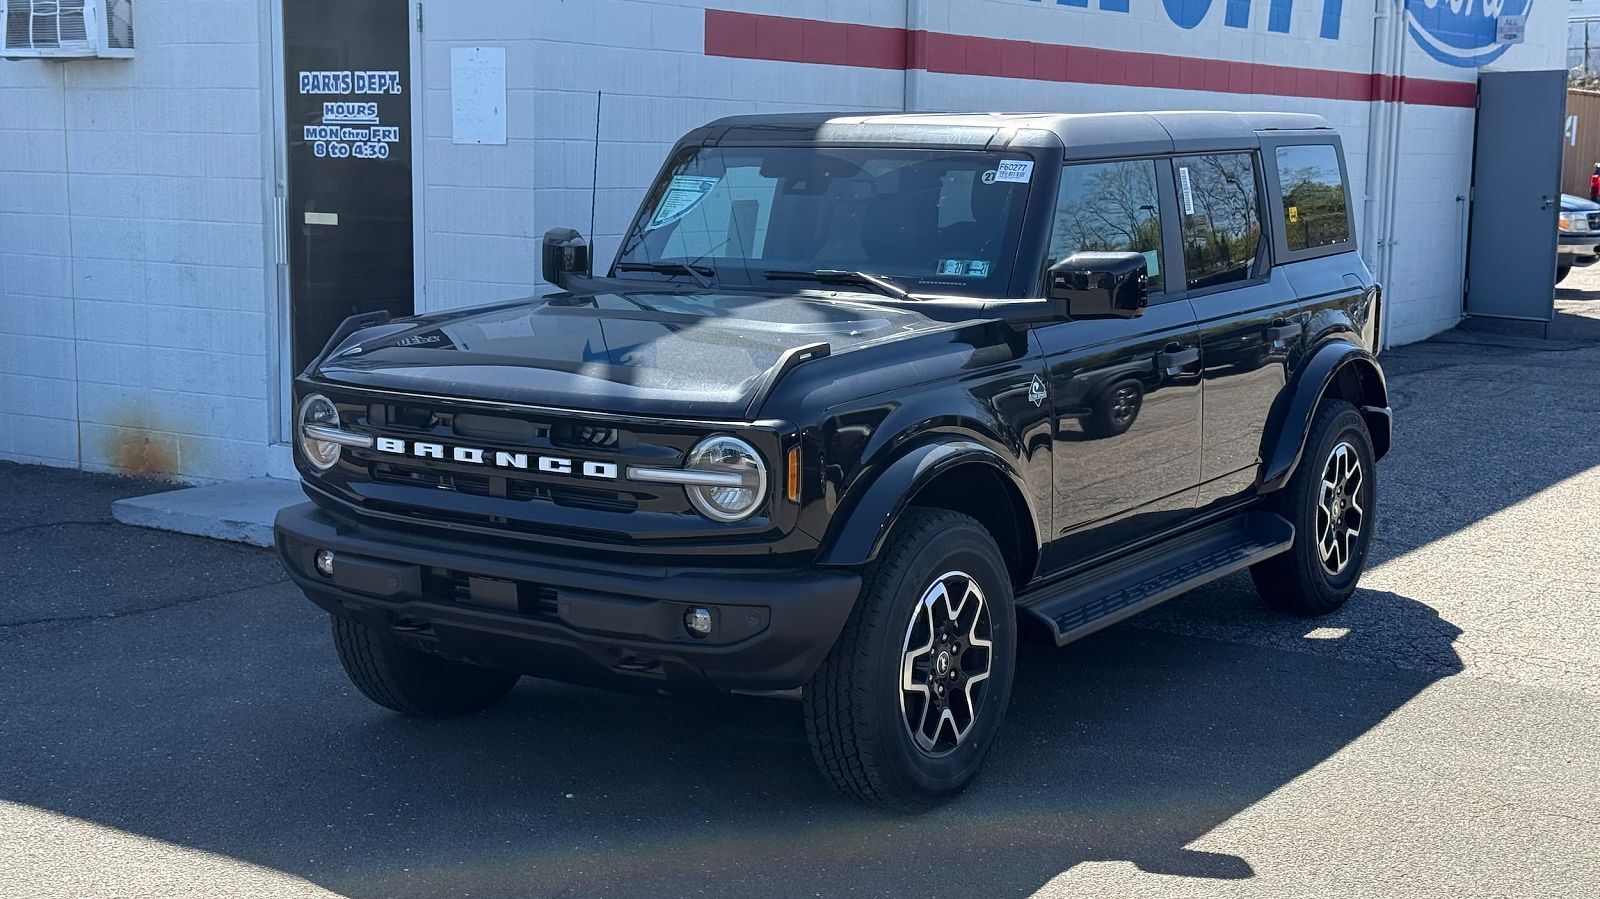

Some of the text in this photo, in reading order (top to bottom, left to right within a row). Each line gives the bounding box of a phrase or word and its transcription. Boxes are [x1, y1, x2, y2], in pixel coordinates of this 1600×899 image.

[299, 71, 402, 94] PARTS DEPT.
[323, 102, 378, 118] HOURS
[304, 125, 399, 142] MON thru FRI
[314, 141, 389, 158] 8 to 4:30
[1000, 163, 1028, 171] F60277
[376, 436, 618, 479] BRONCO
